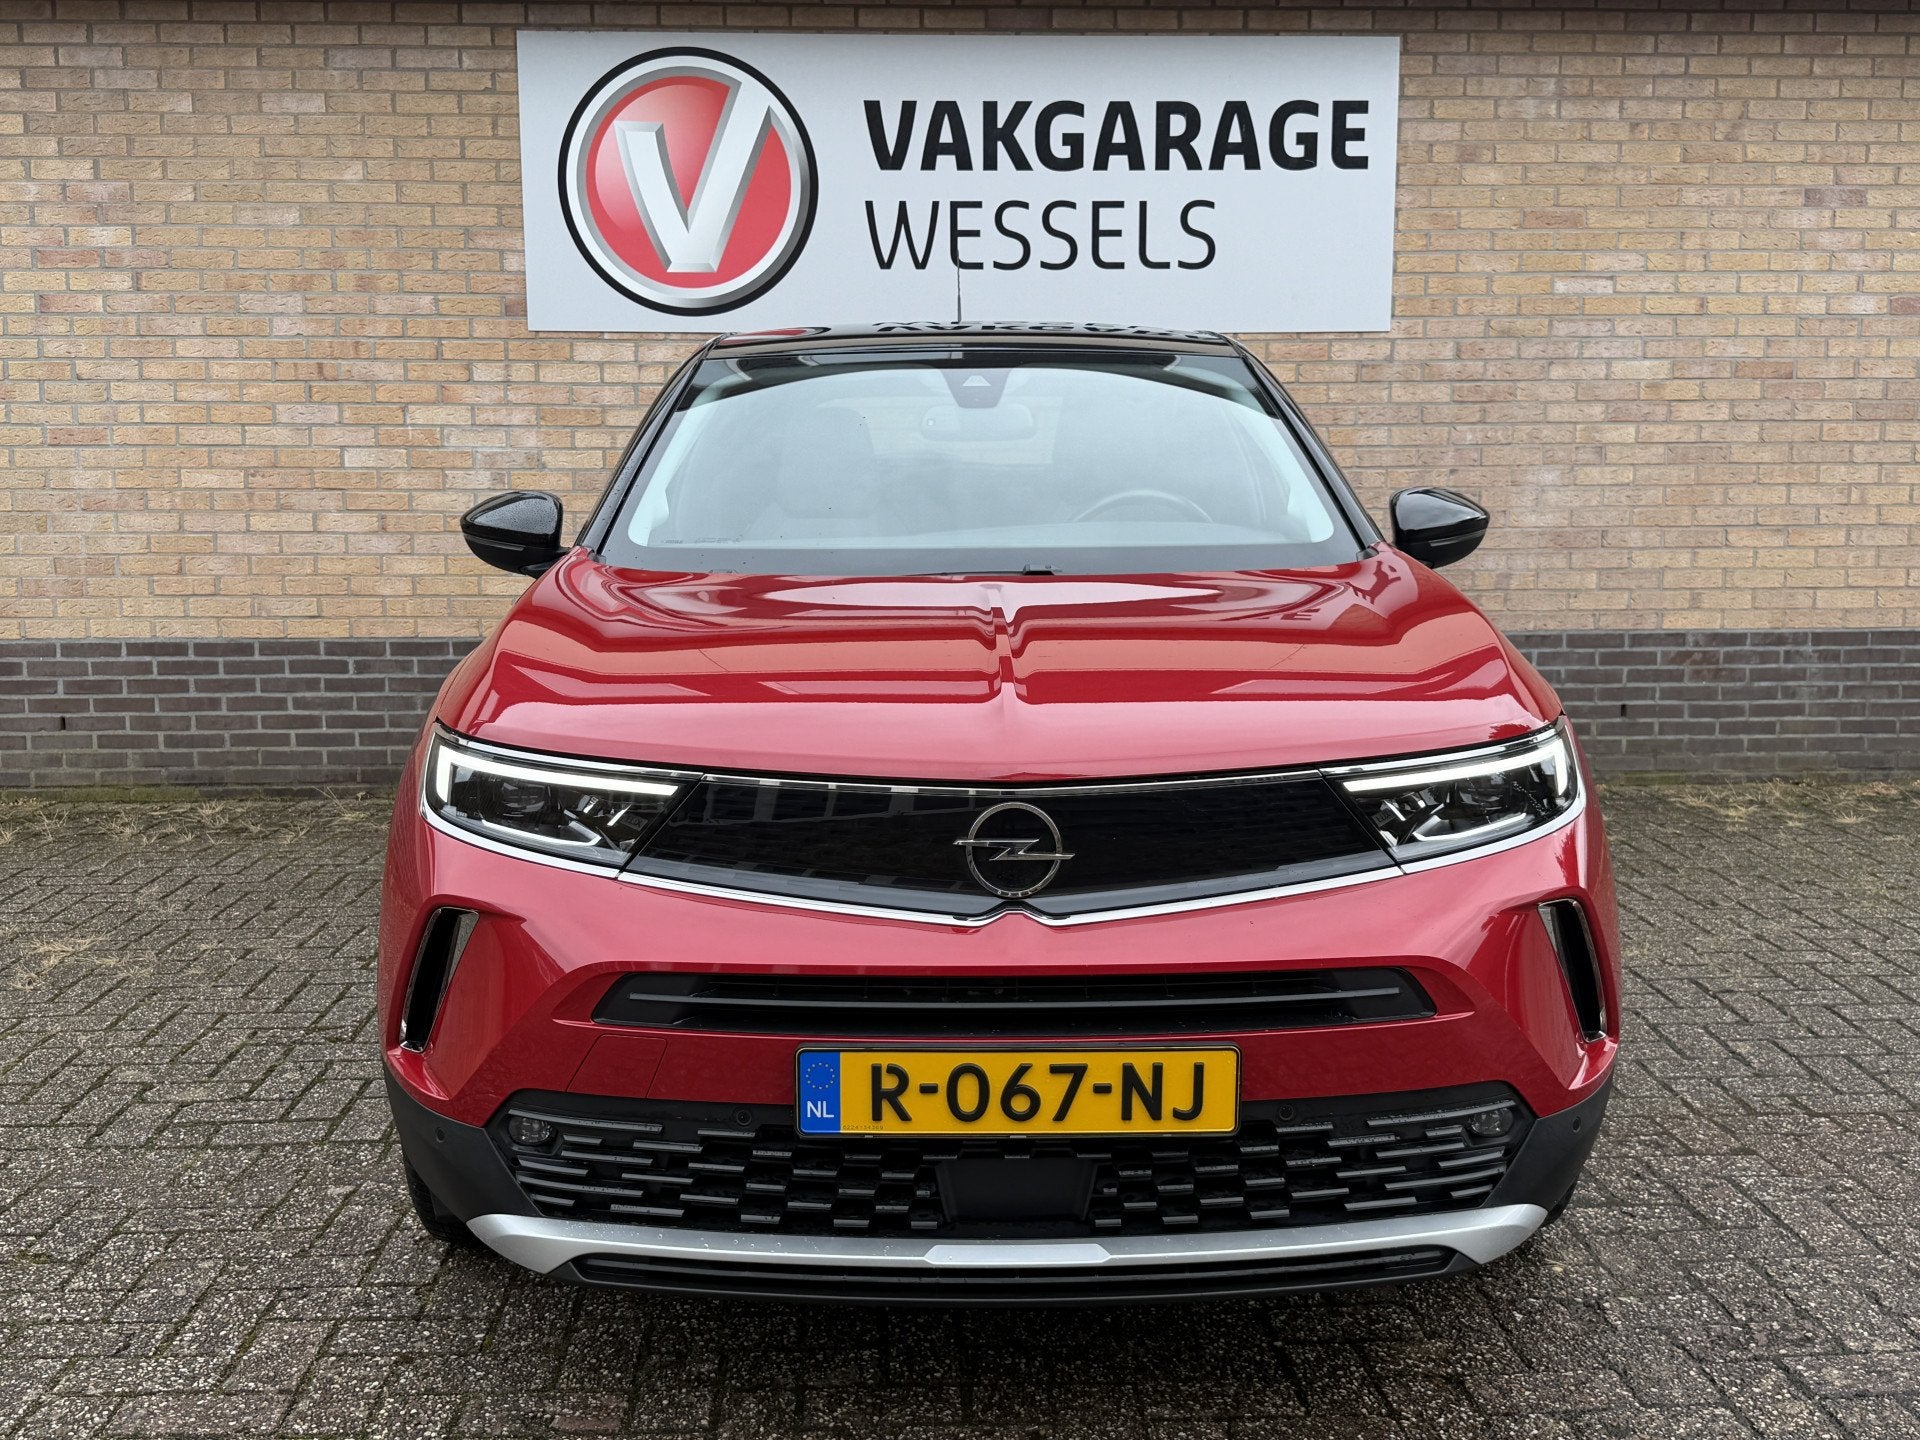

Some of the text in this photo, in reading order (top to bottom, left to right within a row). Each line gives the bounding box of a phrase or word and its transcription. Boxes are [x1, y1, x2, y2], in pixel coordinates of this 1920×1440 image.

[863, 98, 1370, 172] VAKGARAGE
[864, 199, 1217, 271] WESSELS
[806, 1100, 835, 1119] NL
[870, 1062, 1205, 1122] R-067-NJ
